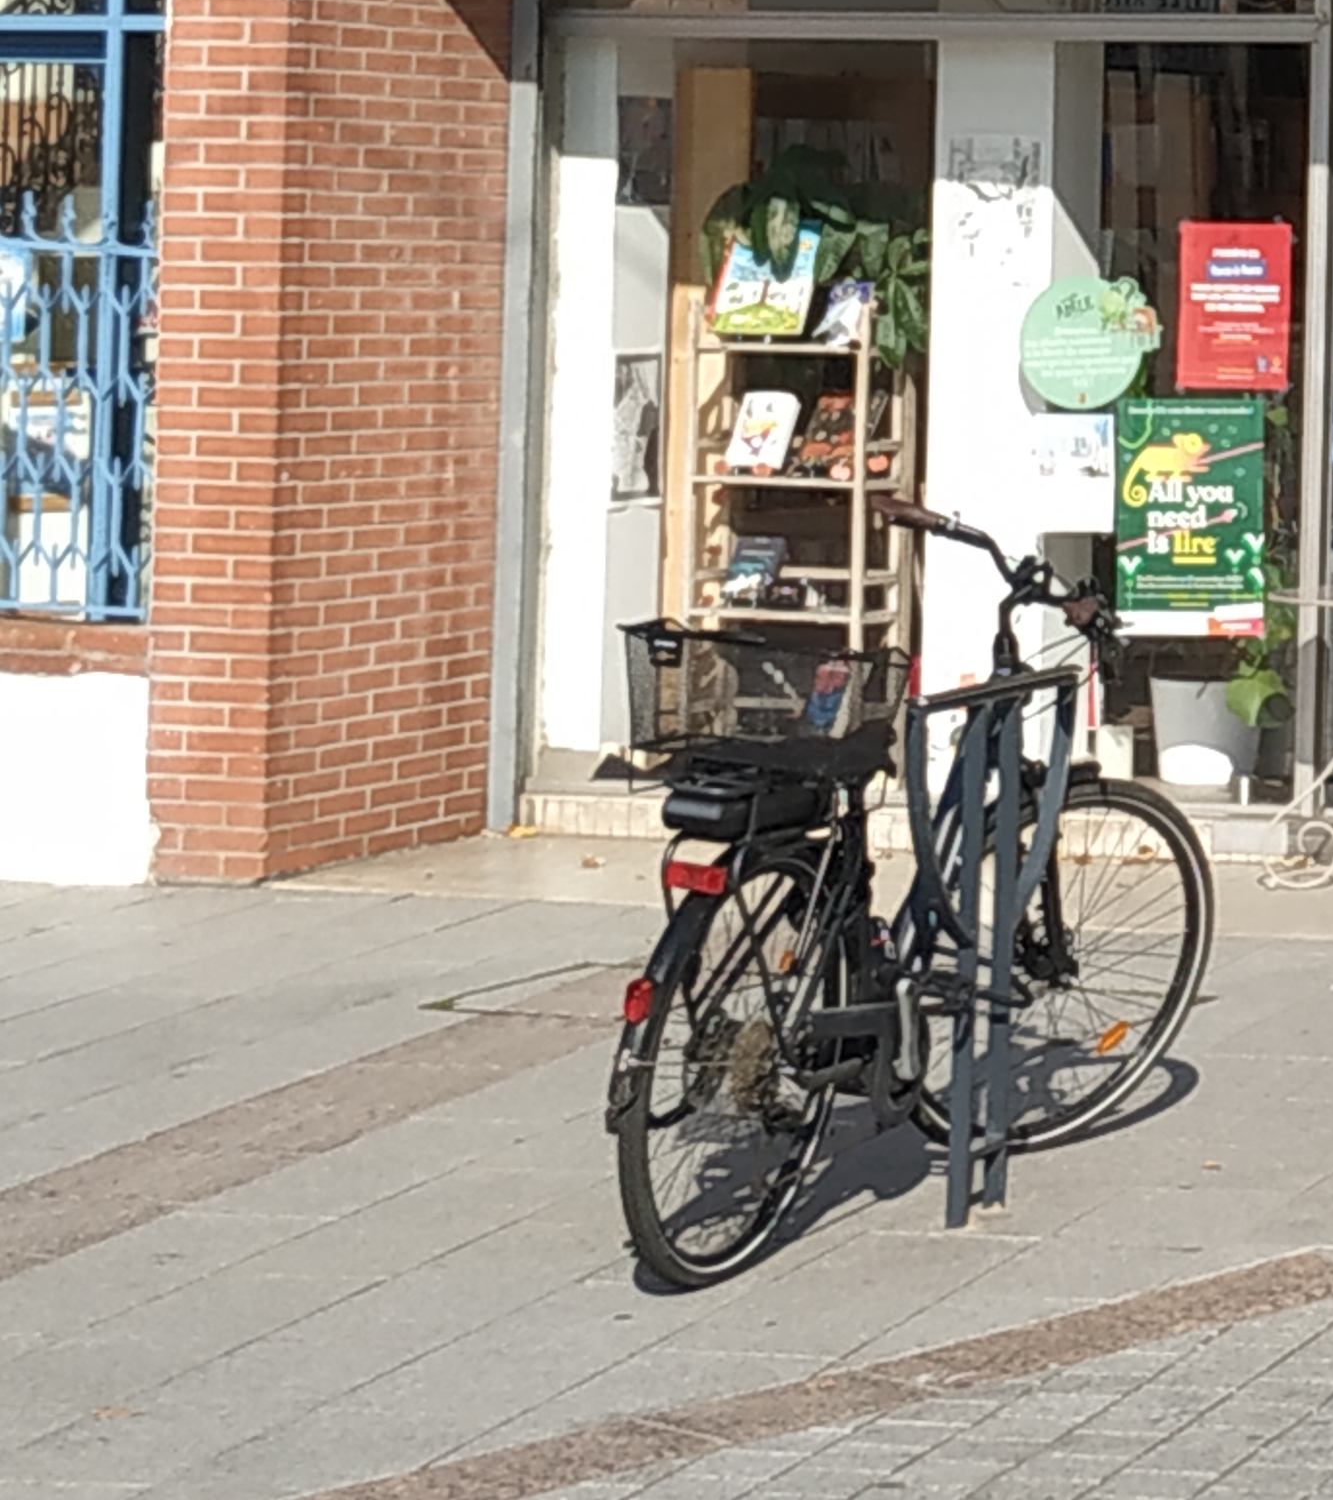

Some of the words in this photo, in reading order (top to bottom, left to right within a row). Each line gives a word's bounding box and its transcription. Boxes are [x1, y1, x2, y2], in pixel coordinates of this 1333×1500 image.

[1147, 480, 1183, 503] All
[1186, 484, 1234, 508] you
[1147, 505, 1206, 528] need
[1172, 530, 1217, 554] lire
